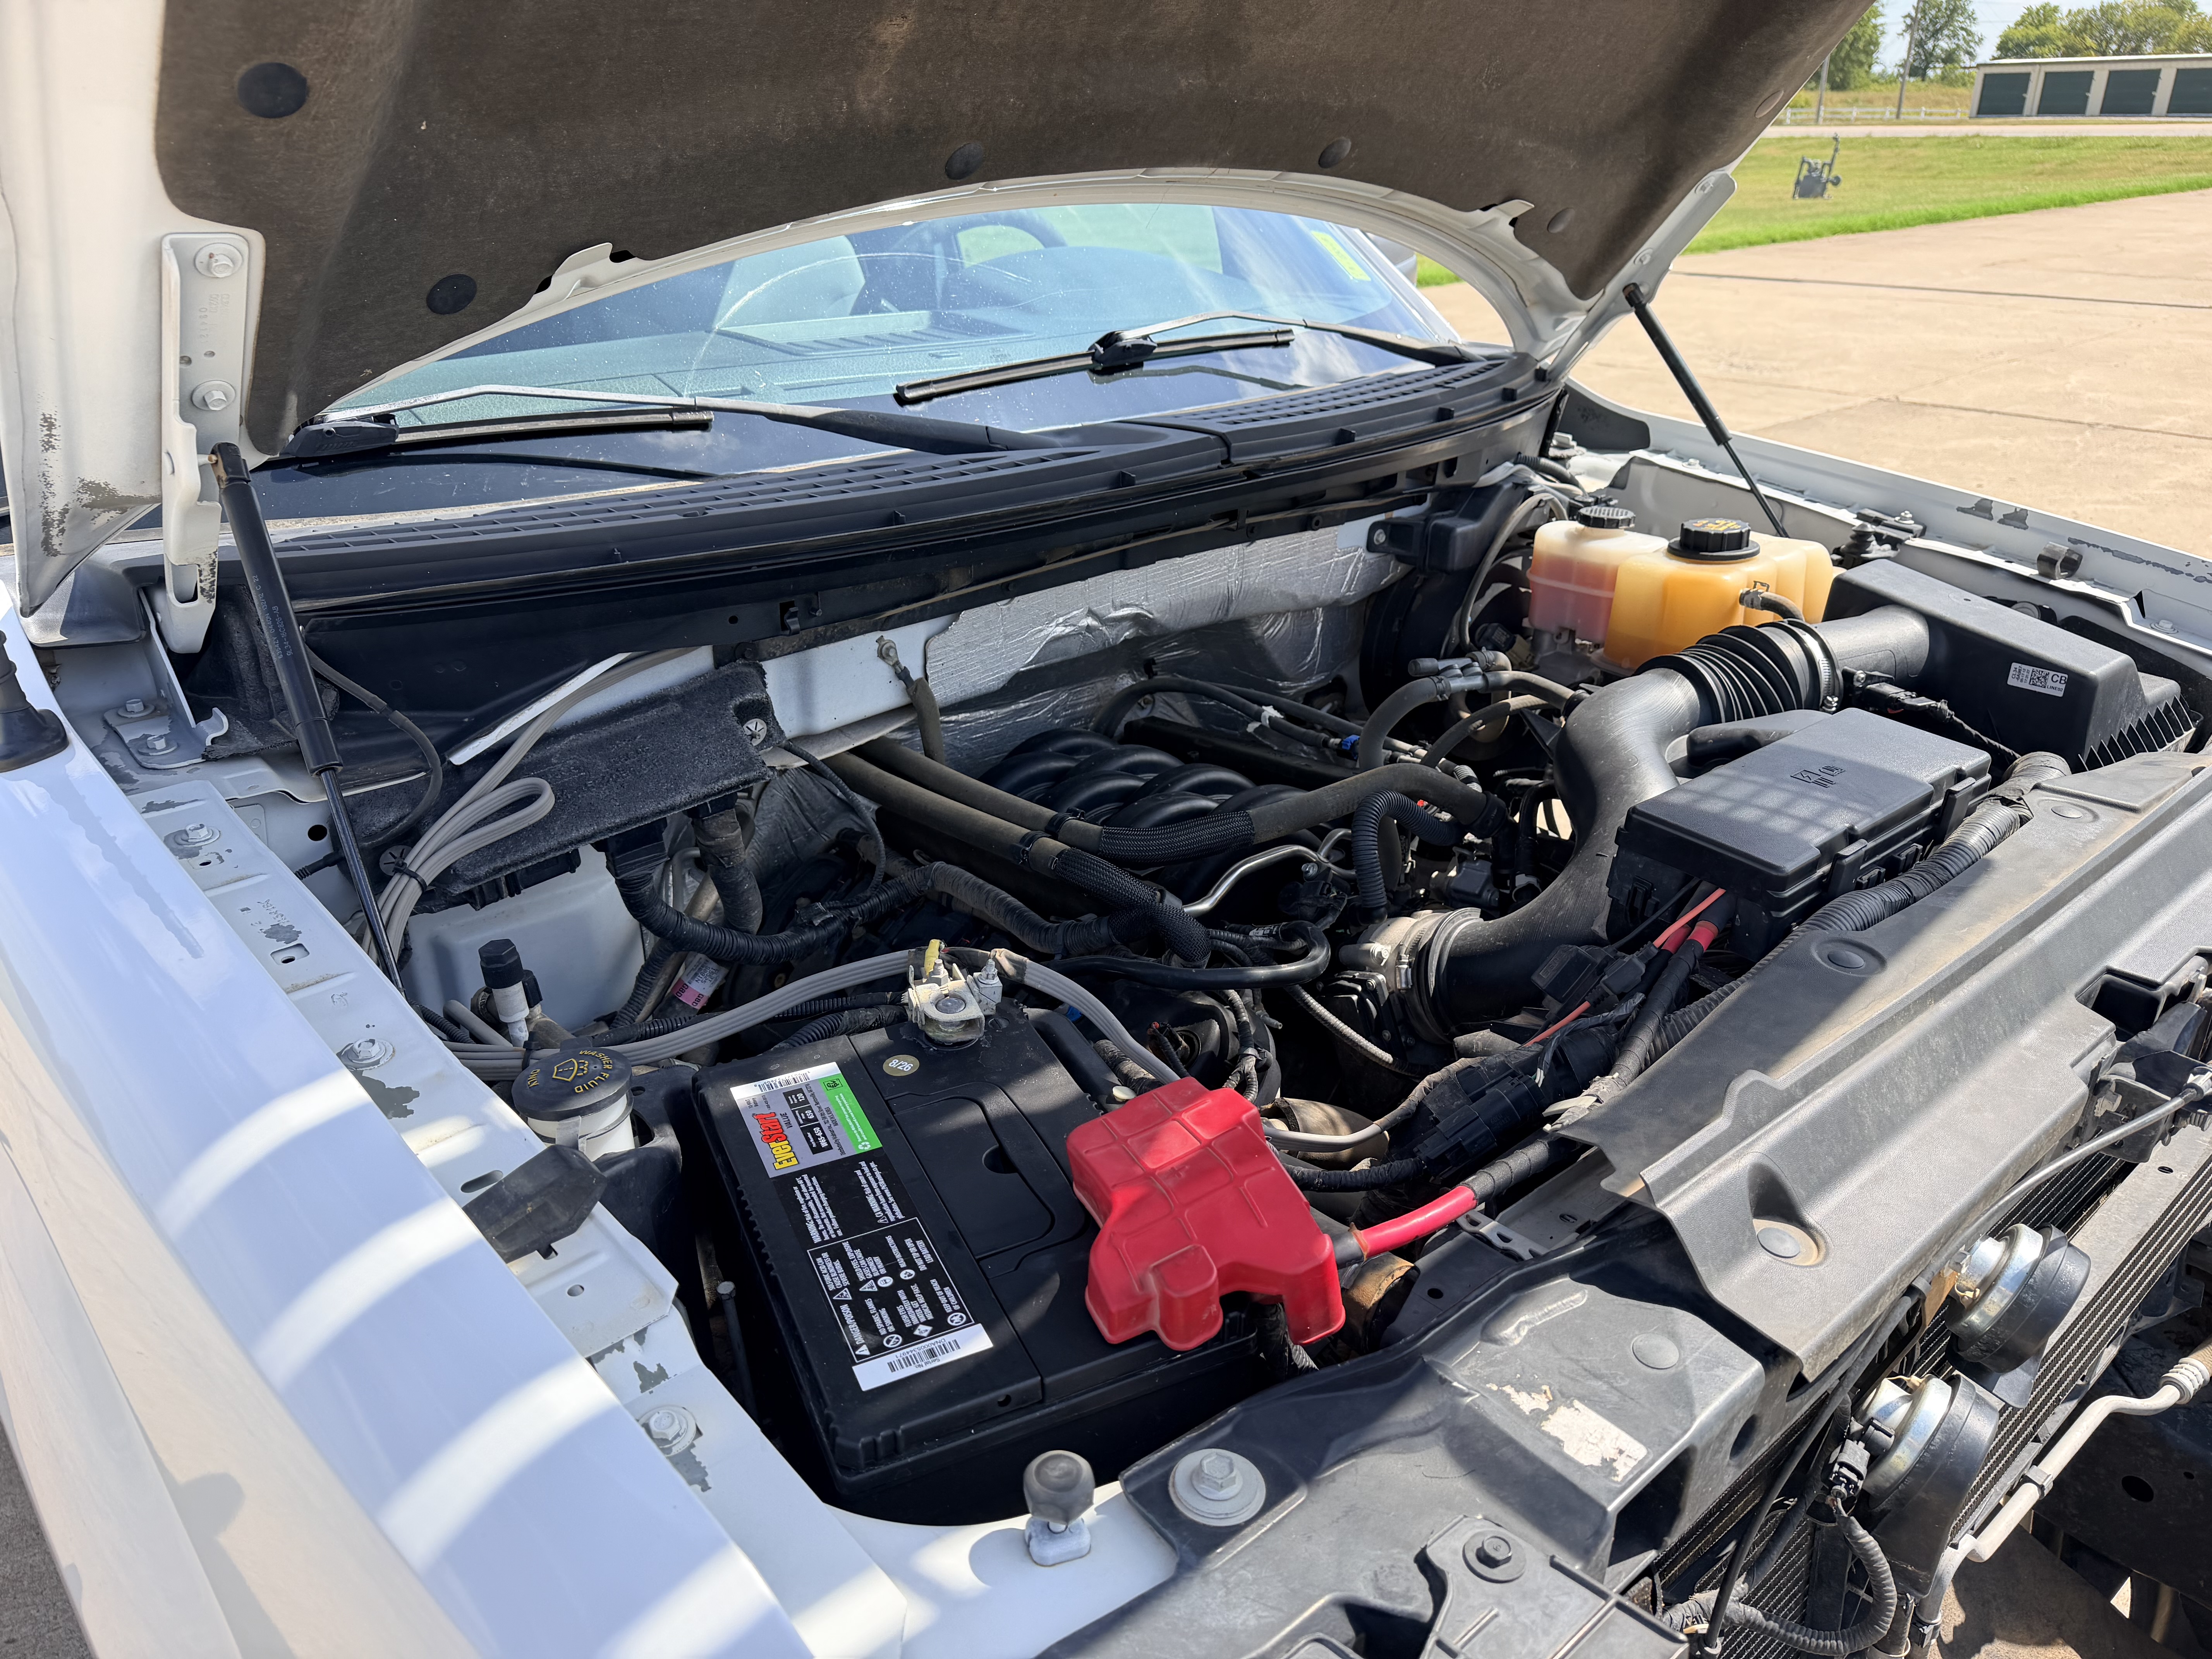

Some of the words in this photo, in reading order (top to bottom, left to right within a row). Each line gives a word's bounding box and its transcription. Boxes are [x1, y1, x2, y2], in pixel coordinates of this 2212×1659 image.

[2051, 674, 2067, 684] CB
[579, 1050, 613, 1070] WASHER
[889, 1059, 914, 1072] 8/26
[527, 1068, 540, 1089] ONLY
[574, 1072, 609, 1093] FLUID
[797, 1093, 805, 1101] 120
[780, 1112, 792, 1128] VALUE
[805, 1110, 814, 1118] 650
[753, 1112, 799, 1170] EverStart
[813, 1127, 828, 1147] W65-650
[806, 1219, 821, 1243] WARNING:
[885, 1235, 901, 1258] INSTRUCTIONS
[904, 1238, 914, 1248] OPEN
[916, 1240, 929, 1254] BATTERY
[842, 1241, 855, 1259] EXPLOSIVE
[854, 1249, 864, 1260] CAUSE
[816, 1257, 824, 1265] CAN
[850, 1258, 860, 1268] EYES.
[859, 1259, 867, 1267] CAN
[873, 1256, 884, 1269] INJURY
[897, 1258, 906, 1267] READ
[914, 1257, 924, 1266] NOT
[923, 1254, 933, 1263] LEAD
[819, 1265, 828, 1273] ACID
[824, 1257, 837, 1277] BLINDNESS
[833, 1259, 843, 1273] BURNS.
[862, 1267, 872, 1278] GASES
[866, 1257, 879, 1276] BLINDNESS
[838, 1272, 850, 1286] SEVERE
[855, 1268, 866, 1281] SHIELD
[823, 1273, 835, 1290] SULFURIC
[832, 1276, 842, 1288] CAUSE
[930, 1279, 941, 1291] REACH
[897, 1290, 907, 1300] WITH
[910, 1283, 920, 1294] FAST.
[915, 1293, 925, 1303] HELP
[943, 1287, 957, 1304] CHILDREN
[865, 1298, 876, 1313] FLAMES
[896, 1305, 906, 1315] EYES
[902, 1300, 919, 1324] IMMEDIATELY
[921, 1303, 933, 1319] MEDICAL
[943, 1303, 952, 1312] KEEP
[872, 1312, 884, 1329] SPARKS,
[879, 1308, 892, 1326] SMOKING
[901, 1314, 912, 1327] FLUSH
[915, 1307, 926, 1322] WATER.
[840, 1304, 864, 1344] DANGER/POISON
[895, 1338, 945, 1358] DNA0005344971
[924, 1357, 940, 1366] Serial
